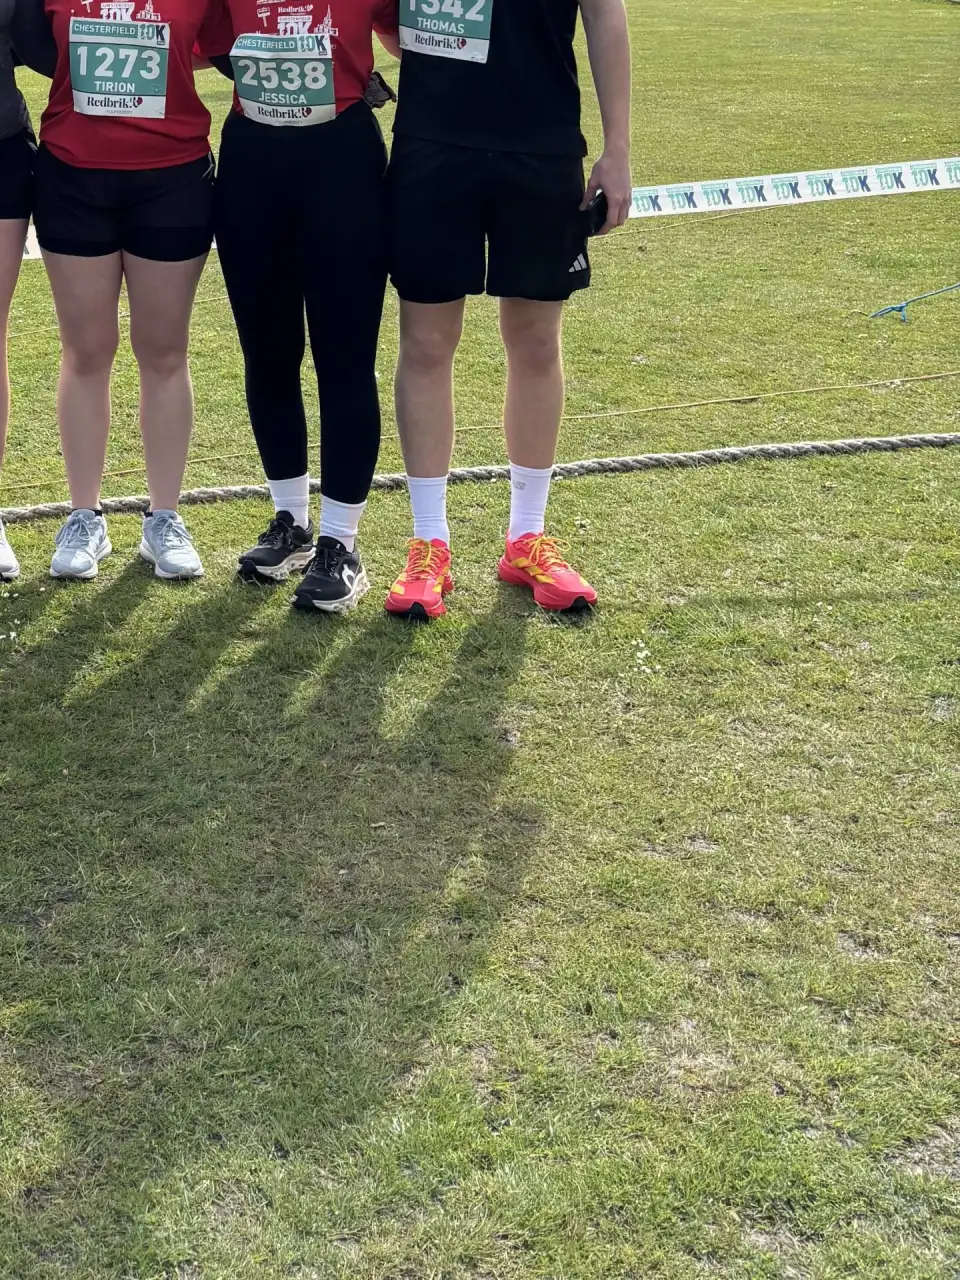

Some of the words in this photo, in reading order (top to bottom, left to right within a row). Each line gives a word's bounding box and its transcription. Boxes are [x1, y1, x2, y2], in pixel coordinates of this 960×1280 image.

[100, 8, 135, 21] 10K
[74, 23, 136, 35] CHESTERFIELD
[139, 24, 166, 42] 10K
[278, 21, 312, 35] 10K
[417, 17, 465, 34] THOMAS
[236, 38, 295, 49] CHESTERFIELD
[297, 35, 327, 53] 10K
[77, 45, 161, 80] 1273
[238, 59, 327, 91] 2538
[94, 81, 136, 93] TIRION
[258, 91, 307, 104] JESSICA
[842, 175, 871, 193] 10K
[877, 172, 906, 190] 10K
[912, 169, 940, 186] 10K
[738, 185, 767, 203] 10K
[773, 182, 802, 200] 10K
[808, 179, 837, 196] 10K
[633, 195, 662, 212] 10K
[668, 192, 697, 210] 10K
[703, 188, 733, 206] 10K
